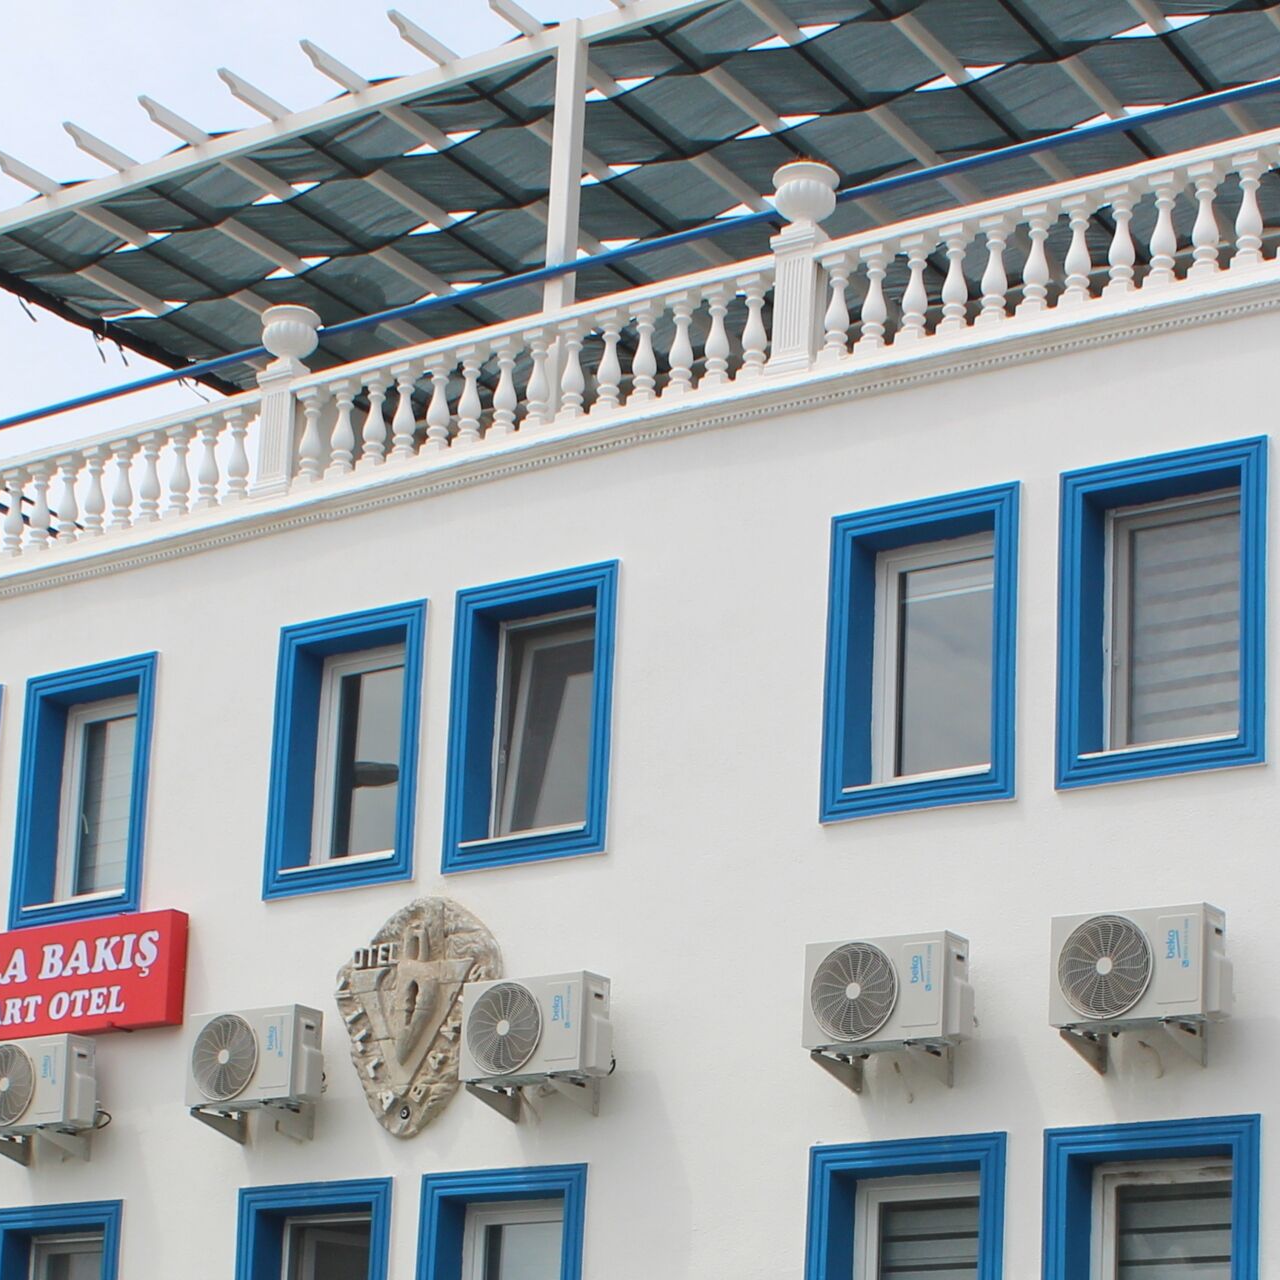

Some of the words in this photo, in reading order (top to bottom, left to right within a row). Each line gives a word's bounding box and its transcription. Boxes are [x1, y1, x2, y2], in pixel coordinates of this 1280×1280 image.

[38, 930, 159, 977] BAKIŞ
[1165, 929, 1177, 959] beko
[910, 955, 921, 984] beko
[48, 984, 125, 1021] OTEL
